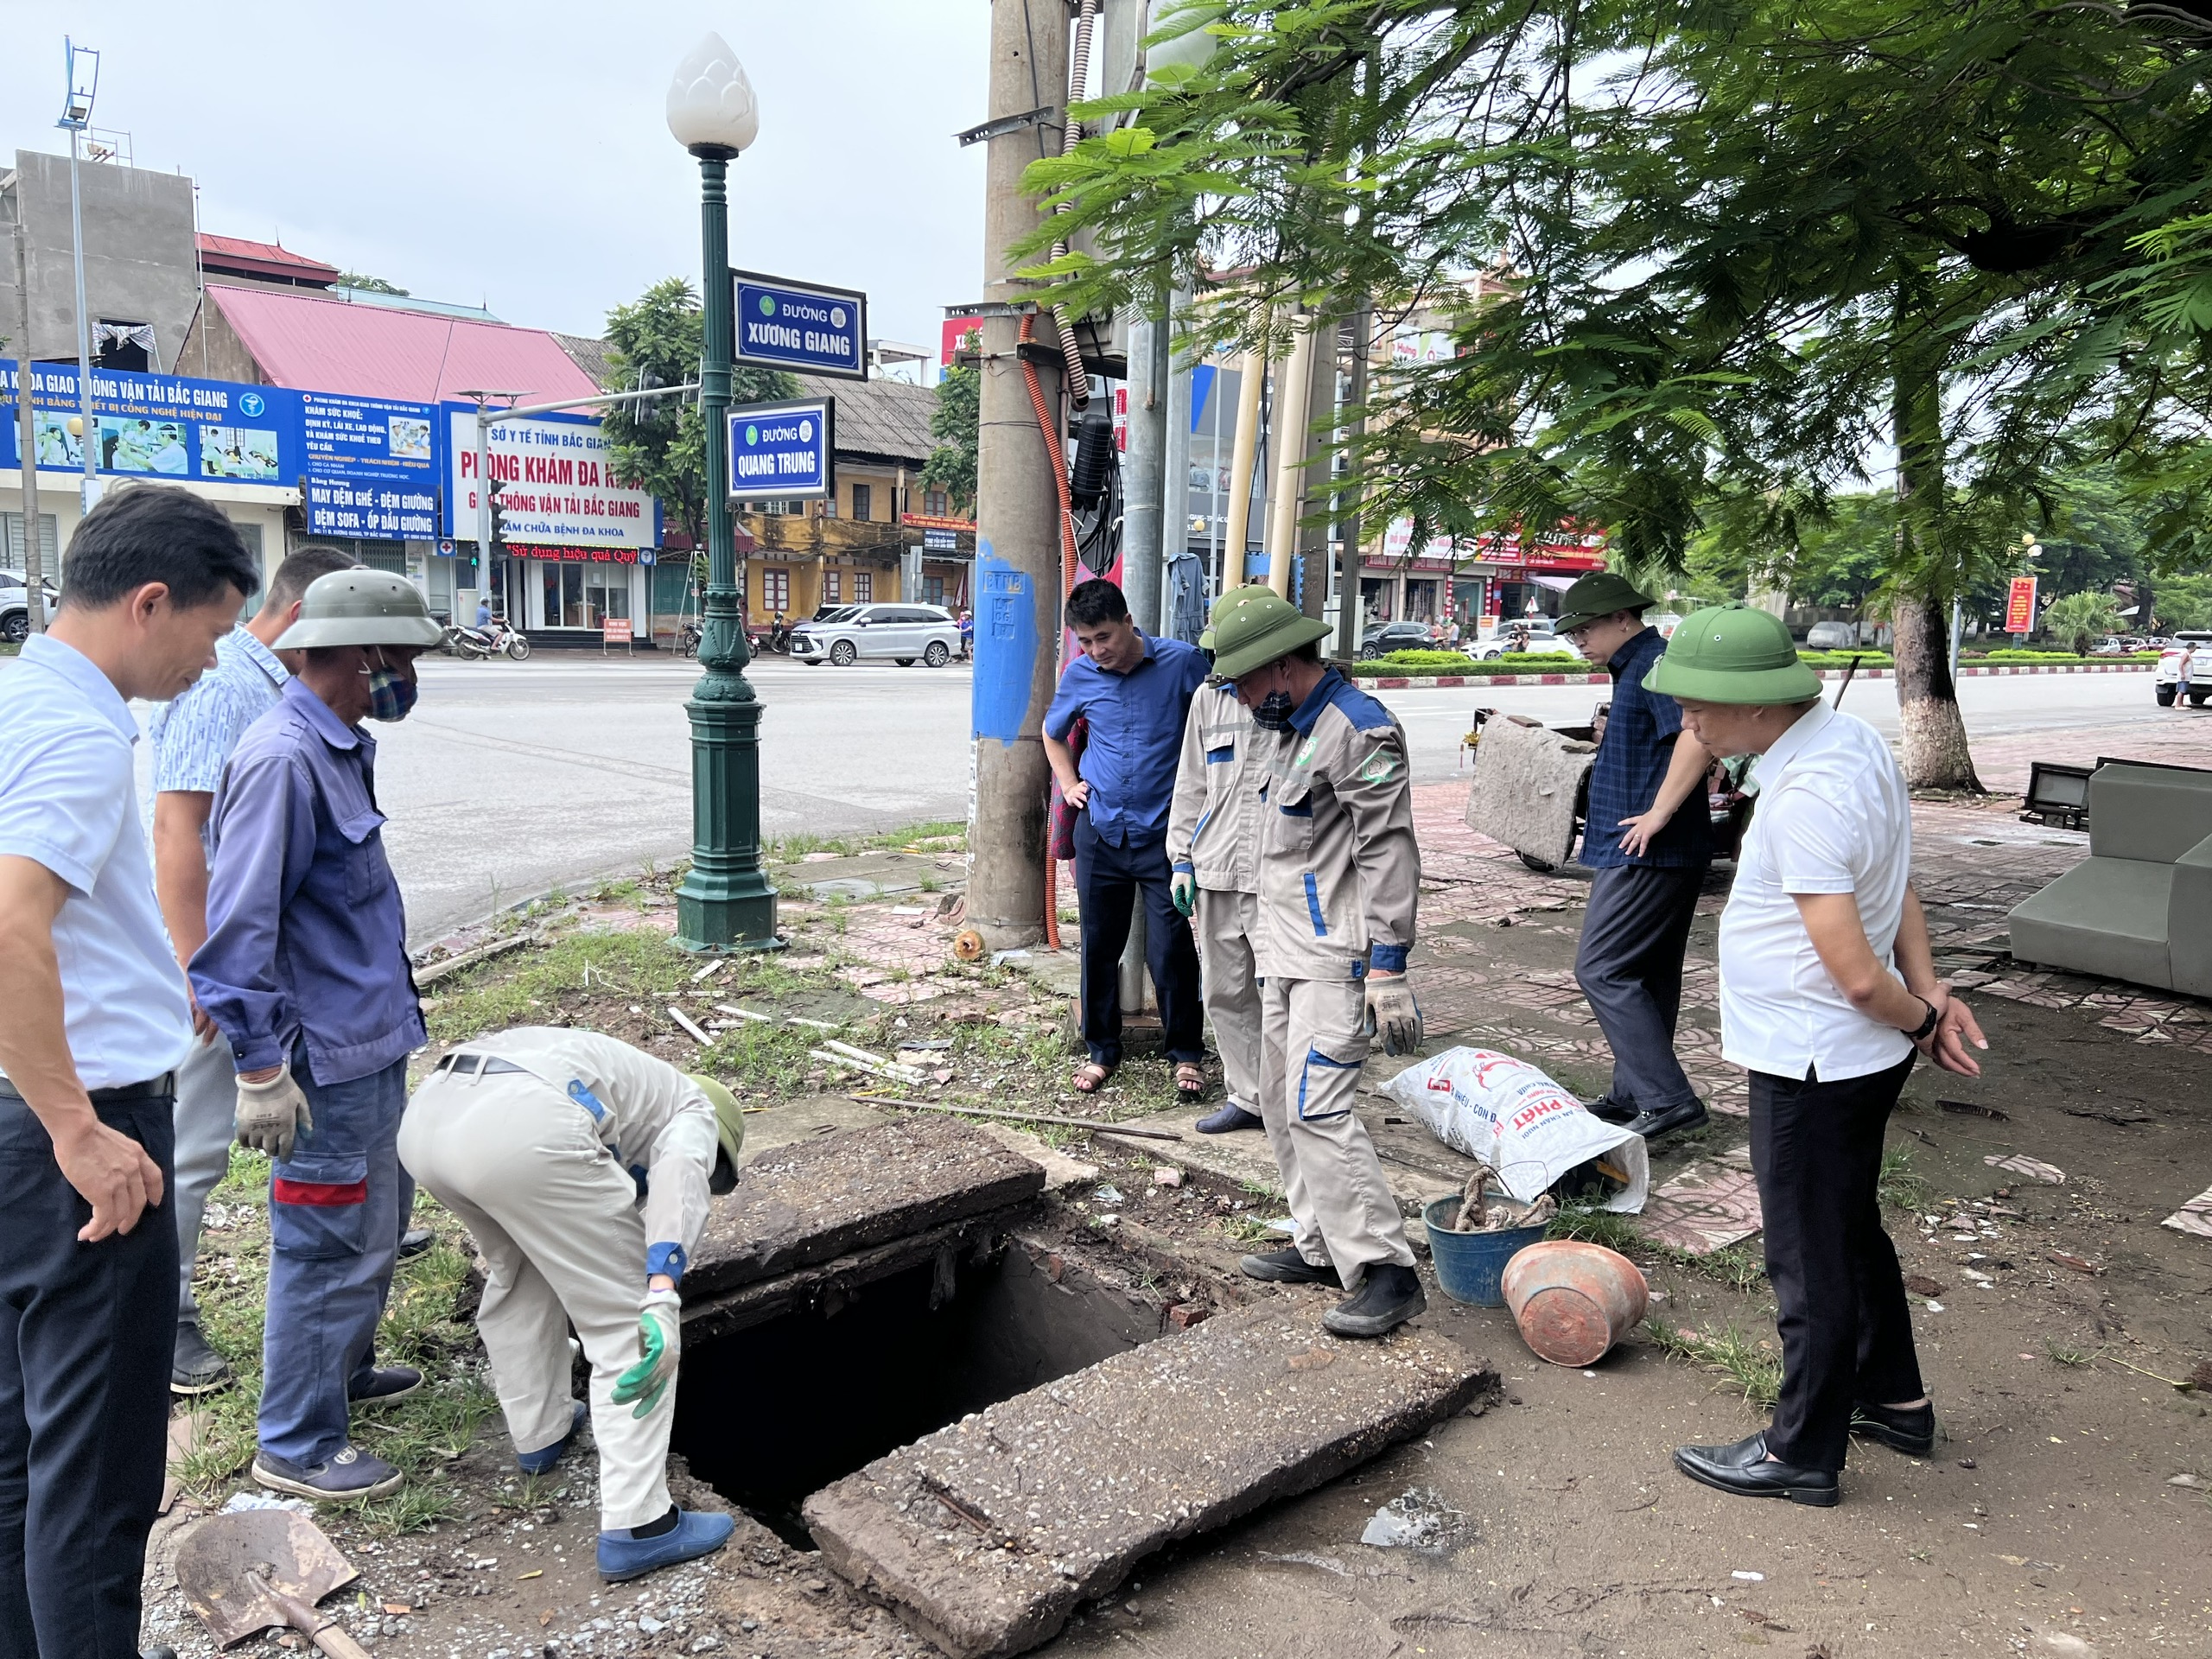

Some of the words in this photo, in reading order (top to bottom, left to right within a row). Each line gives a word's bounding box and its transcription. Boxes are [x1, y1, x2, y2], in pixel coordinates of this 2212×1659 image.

[782, 303, 828, 322] ĐƯỜNG
[747, 321, 801, 350] XƯƠNG
[804, 330, 850, 358] GIANG
[11, 372, 44, 391] KOA
[47, 374, 75, 394] GIAO
[77, 374, 117, 399] TÔNG
[120, 378, 144, 402] VẬN
[146, 379, 165, 403] TẢI
[168, 381, 190, 404] BẮC
[194, 389, 228, 409] GIANG
[47, 395, 75, 408] BẰNG
[108, 401, 119, 414] BỊ
[120, 400, 149, 415] CÔNG
[151, 406, 177, 417] NGHỆ
[180, 409, 204, 422] HIỆN
[206, 412, 222, 423] ĐẠI
[305, 405, 326, 416] KHÁM
[327, 407, 341, 417] SỨC
[315, 430, 334, 441] KHÁM
[335, 431, 348, 442] SỨC
[334, 420, 343, 429] LÁI
[356, 423, 366, 432] LAO
[762, 425, 798, 442] ĐƯỜNG
[306, 441, 318, 450] YÊU
[492, 425, 505, 441] SỞ
[510, 430, 516, 442] Y
[519, 428, 531, 443] TẾ
[535, 429, 558, 446] TỈNH
[563, 432, 582, 448] BẮC
[587, 437, 612, 450] GIAN
[525, 452, 572, 486] KHÁM
[578, 461, 599, 487] ĐA
[738, 454, 775, 479] QUANG
[777, 450, 816, 474] TRUNG
[312, 487, 330, 504] MAY
[334, 486, 353, 508] ĐỆM
[355, 487, 372, 507] GHẾ
[380, 491, 399, 512] ĐỆM
[402, 493, 433, 511] GIƯỜNG
[499, 492, 536, 512] THÔNG
[539, 495, 561, 517] VẬN
[564, 492, 580, 514] TẢI
[584, 493, 604, 516] BẮC
[608, 501, 639, 518] GIANG
[315, 508, 334, 529] ĐỆM
[337, 512, 359, 528] SOFA
[367, 510, 378, 530] ỐP
[401, 513, 432, 532] GIƯỜNG
[524, 521, 551, 533] CHỮA
[554, 523, 579, 537] BỆNH
[582, 526, 595, 536] ĐA
[598, 527, 624, 537] KHOA
[531, 545, 561, 560] dụng
[563, 547, 588, 560] hiệu
[591, 549, 610, 563] quả
[613, 550, 637, 564] Quỹ
[1473, 1103, 1488, 1120] CON
